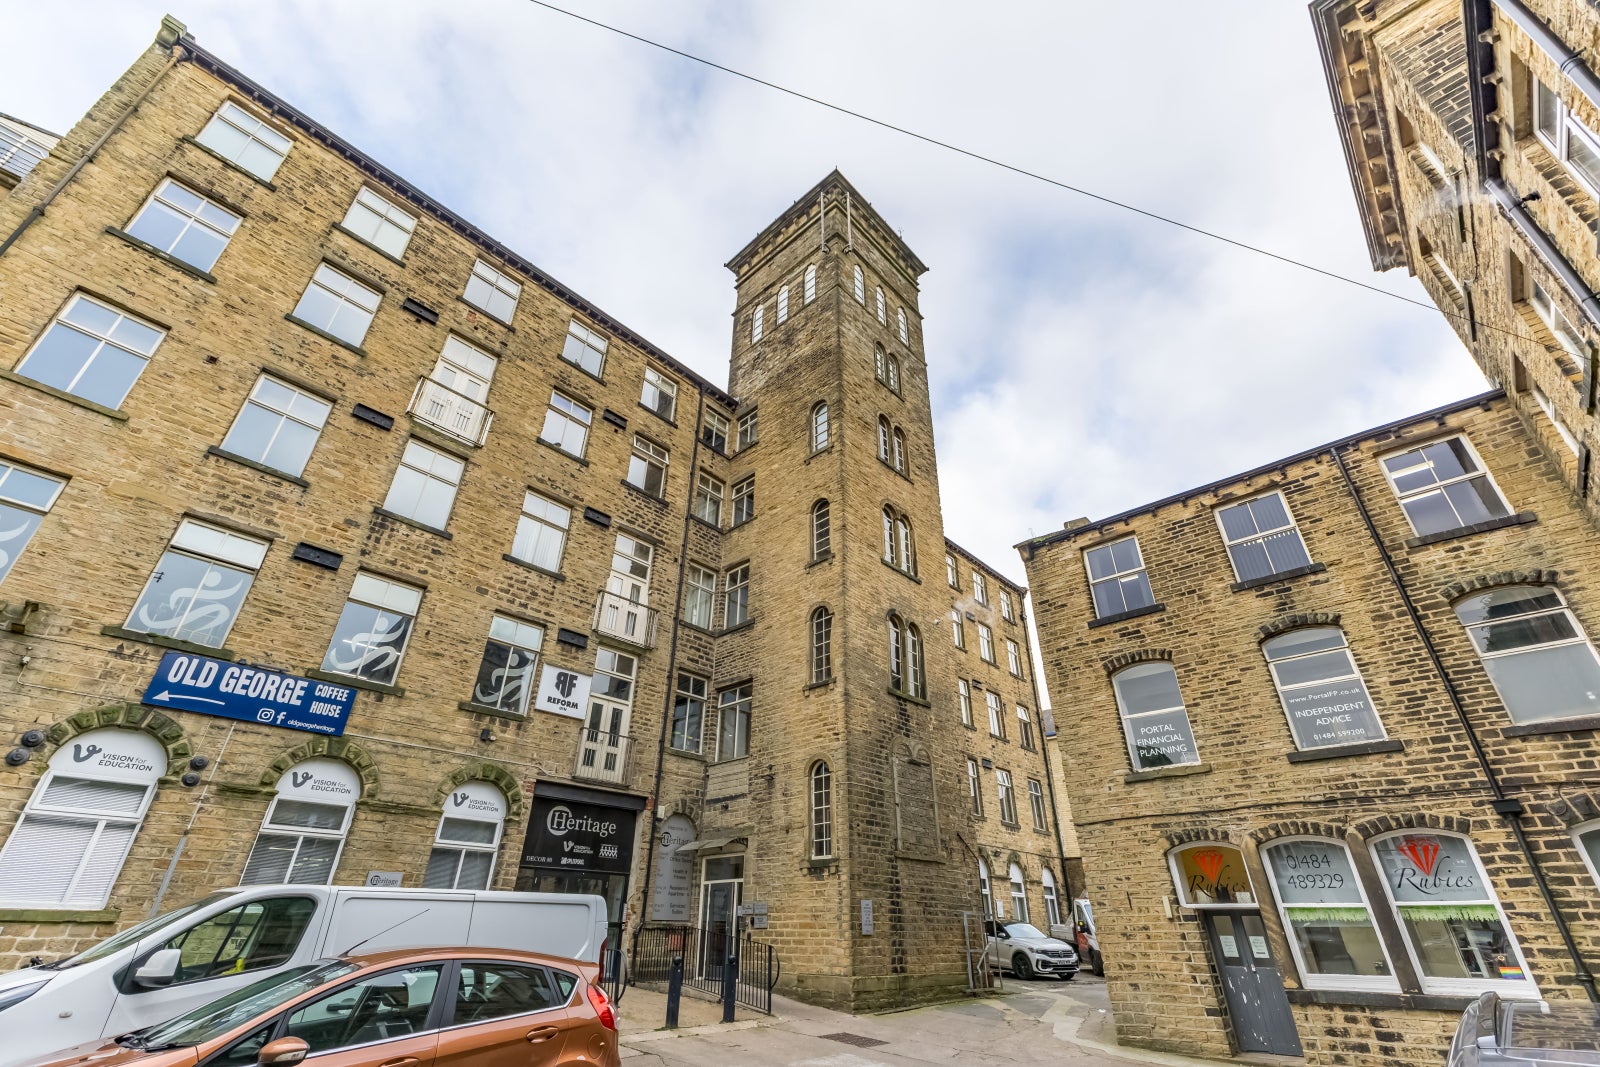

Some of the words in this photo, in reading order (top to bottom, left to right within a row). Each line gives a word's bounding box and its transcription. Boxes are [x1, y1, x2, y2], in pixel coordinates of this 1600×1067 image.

[167, 656, 219, 689] OLD
[219, 666, 309, 706] GEORGE
[314, 684, 350, 702] COFFEE
[1288, 687, 1361, 704] www.PortalFP.co.uk
[547, 696, 579, 709] REFORM
[309, 701, 343, 718] HOUSE
[1294, 701, 1365, 719] INDEPENDENT
[1315, 714, 1352, 726] ADVICE
[1140, 723, 1175, 735] PORTAL
[1136, 733, 1185, 746] FINANCIAL
[1313, 732, 1336, 741] 01484
[102, 752, 134, 763] VISION
[1139, 744, 1188, 758] PLANNING
[98, 760, 153, 772] EDUCATION
[310, 784, 352, 795] EDUCATION
[312, 779, 337, 787] VISION
[467, 804, 499, 813] EDUCATION
[469, 798, 488, 806] VISION
[662, 833, 690, 847] Heritag
[1285, 853, 1332, 870] 01484
[1287, 873, 1344, 890] 489329
[1393, 855, 1475, 897] Rubies
